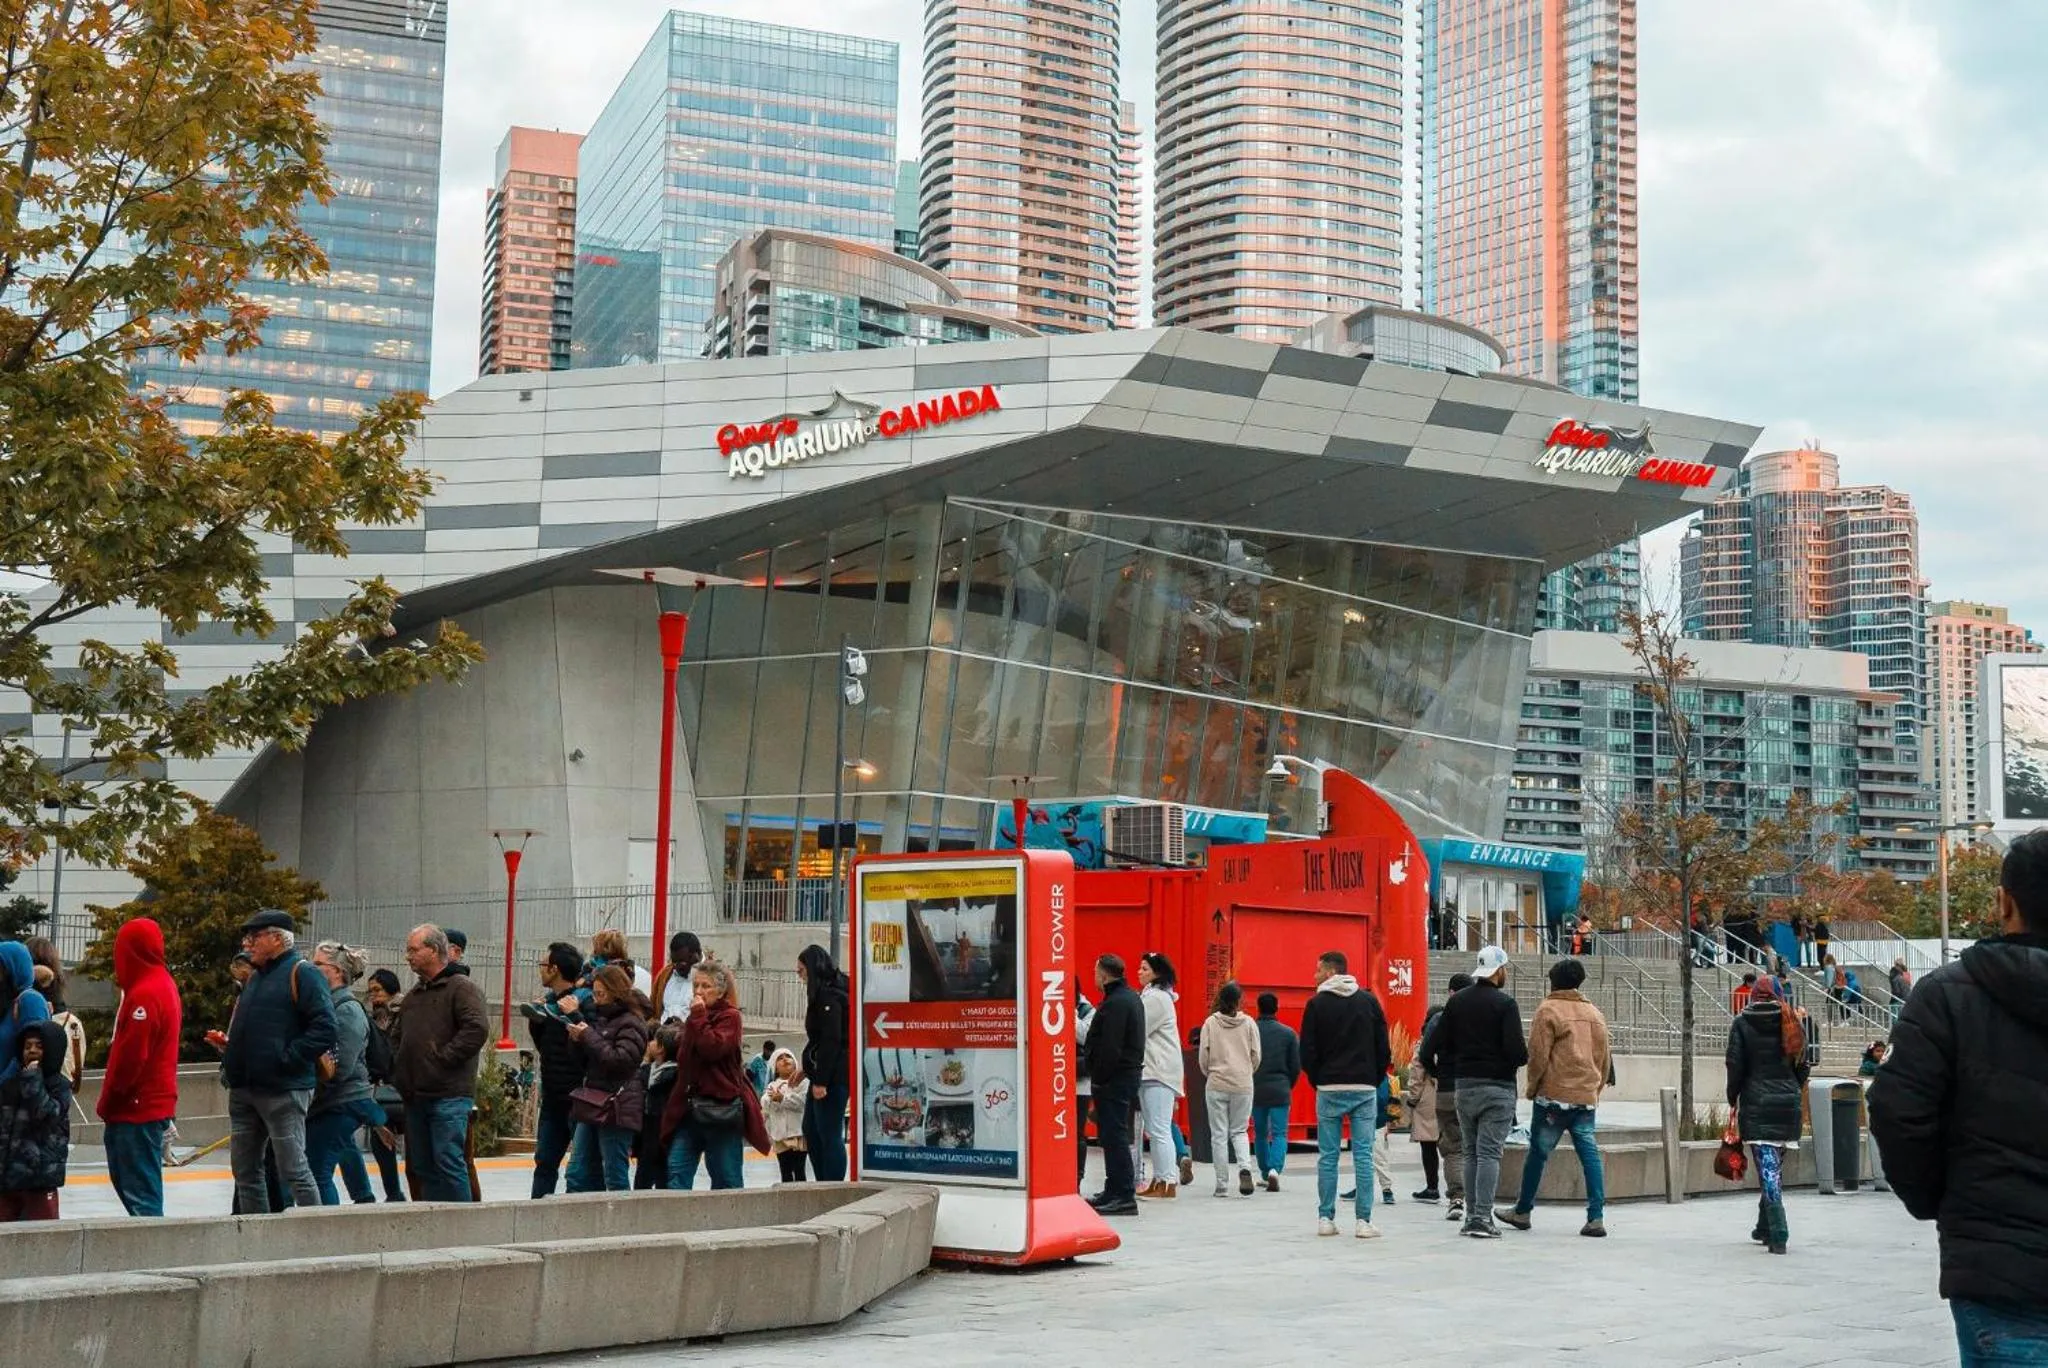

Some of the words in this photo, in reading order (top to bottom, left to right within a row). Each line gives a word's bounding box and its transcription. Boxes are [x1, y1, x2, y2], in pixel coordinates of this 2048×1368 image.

[728, 417, 866, 478] AQUARIUM
[879, 384, 1001, 438] CANADA
[1534, 446, 1638, 478] AQUARIUM
[1302, 848, 1326, 893] THE
[1329, 846, 1365, 891] KIOSK
[1469, 843, 1553, 868] ENTRANCE
[1051, 883, 1065, 963] TOWER
[1041, 970, 1066, 1036] CN
[1053, 1043, 1067, 1103] TOUR
[985, 1089, 1009, 1109] 360
[1055, 1109, 1067, 1140] LA
